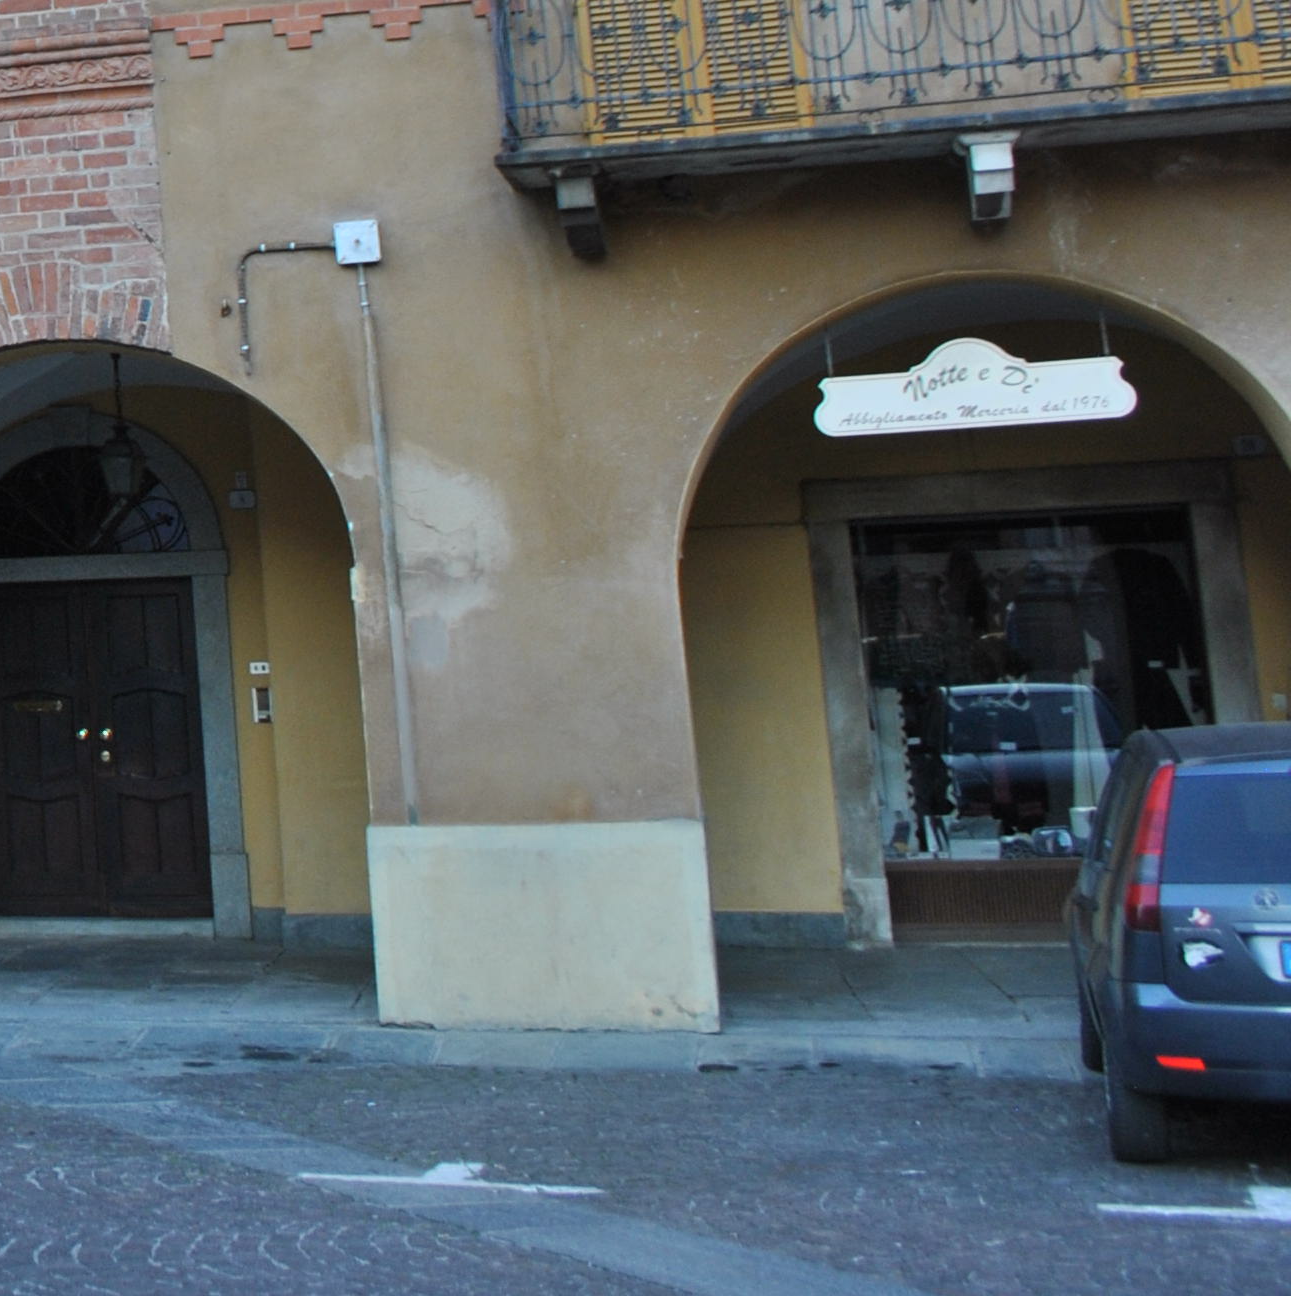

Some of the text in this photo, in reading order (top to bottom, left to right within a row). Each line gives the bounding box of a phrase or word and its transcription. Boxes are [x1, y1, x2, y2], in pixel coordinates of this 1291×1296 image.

[903, 365, 968, 402] Notte
[978, 367, 990, 381] e
[839, 411, 948, 430] Abbigliamento
[957, 404, 1030, 418] Merceria
[1041, 400, 1068, 412] dal
